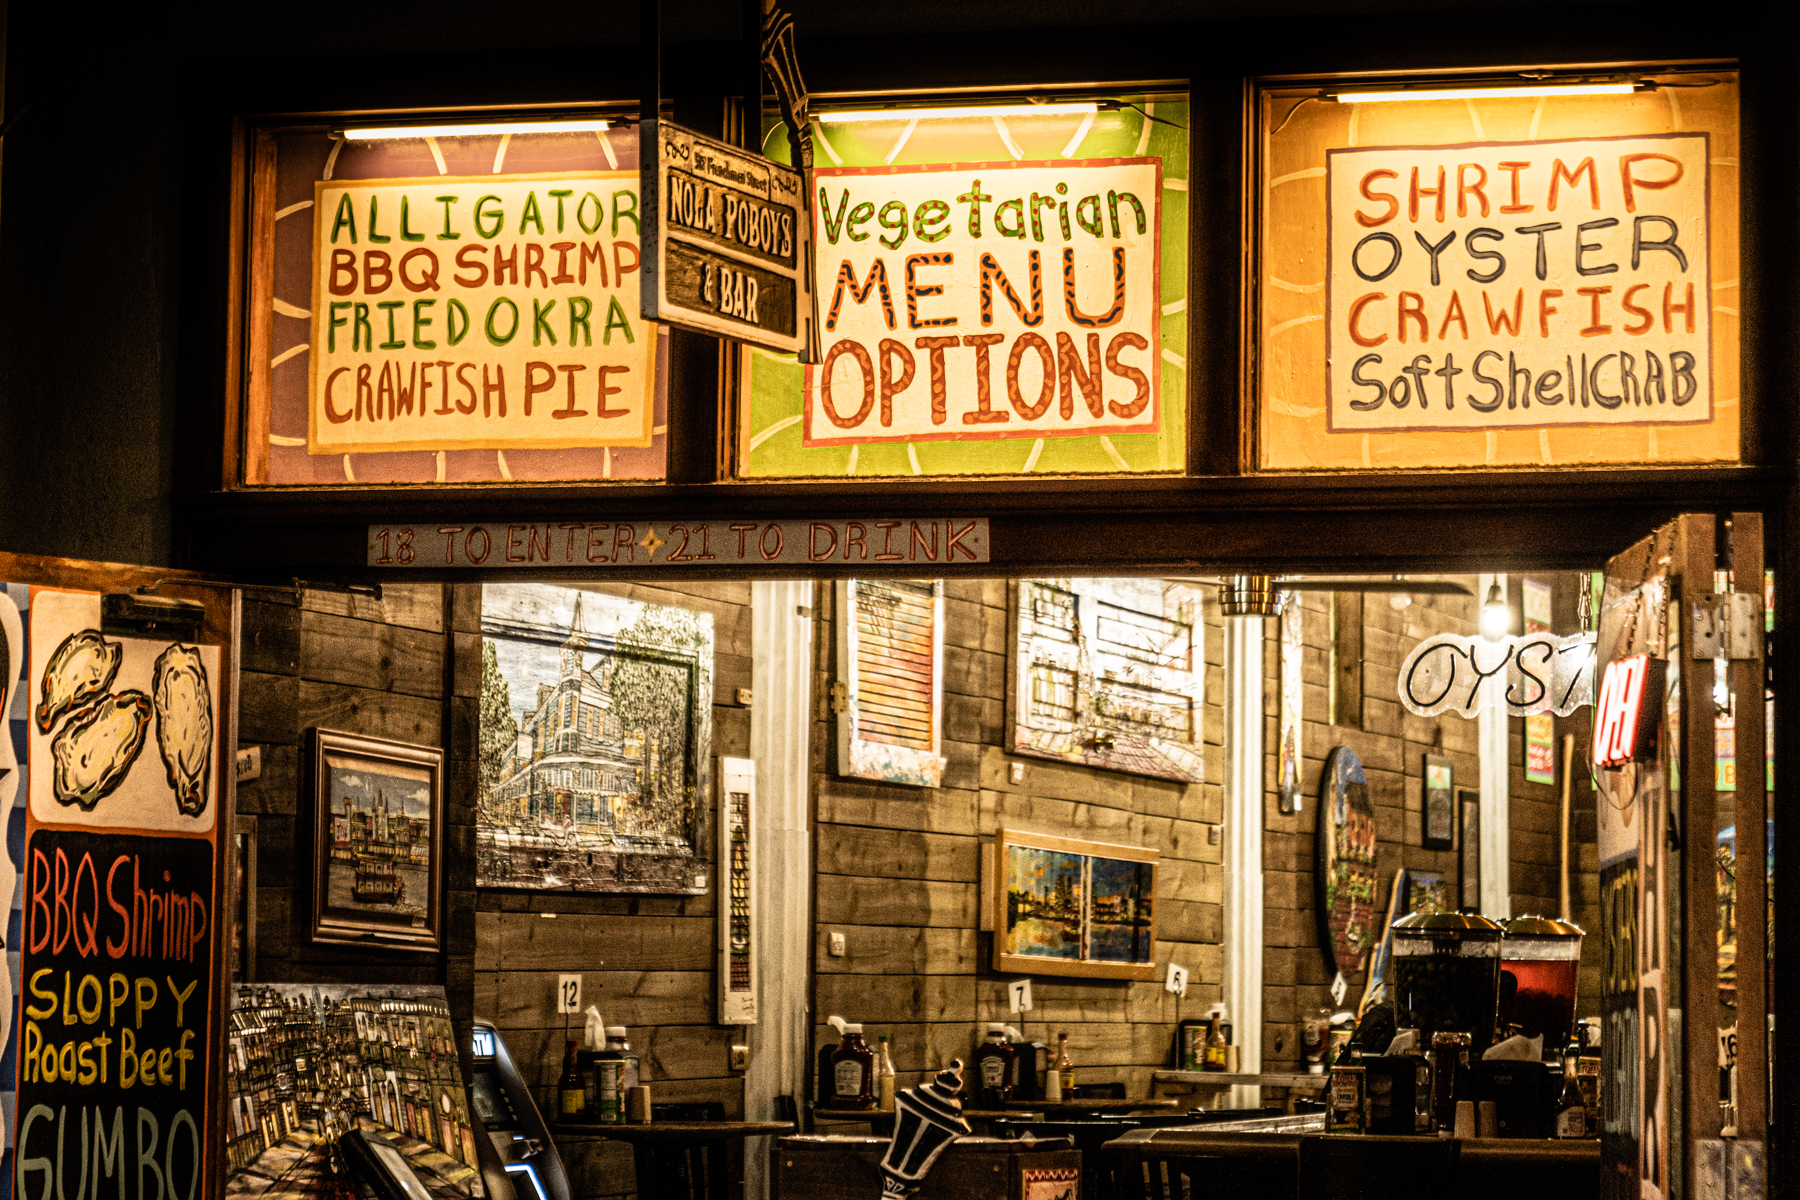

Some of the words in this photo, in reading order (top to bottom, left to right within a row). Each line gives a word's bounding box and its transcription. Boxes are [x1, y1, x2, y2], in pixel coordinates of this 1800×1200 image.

[331, 189, 640, 244] ALLIGATOR
[669, 176, 717, 234] NOLA
[725, 194, 791, 258] POBOYS
[820, 179, 1147, 250] Vegetarian
[1354, 153, 1684, 228] SHRIMP
[328, 247, 440, 296] BBQ
[453, 240, 641, 289] SHRIMP
[1352, 215, 1689, 286] OYSTER
[704, 264, 713, 303] &
[719, 267, 758, 324] BAR
[825, 246, 1126, 332] MENU
[1348, 281, 1696, 348] CRAWFISH
[328, 297, 470, 353] FRIED
[485, 295, 636, 347] OKRA
[324, 359, 507, 424] CRAWFISH
[524, 361, 631, 420] PIE
[821, 331, 1150, 430] OPTIONS
[376, 528, 415, 564] 18
[438, 525, 491, 564] TO
[505, 523, 636, 563] ENTER
[666, 524, 715, 562] 21
[729, 523, 784, 560] TO
[808, 520, 978, 562] DRINK
[30, 846, 99, 960] BBQ
[106, 854, 207, 963] Shrimp
[26, 967, 199, 1029] SLOPPY
[562, 981, 577, 1007] 12
[1016, 986, 1024, 1006] 7
[23, 1021, 112, 1086] Roast
[119, 1029, 195, 1091] Beef
[17, 1104, 199, 1200] GUMBO
